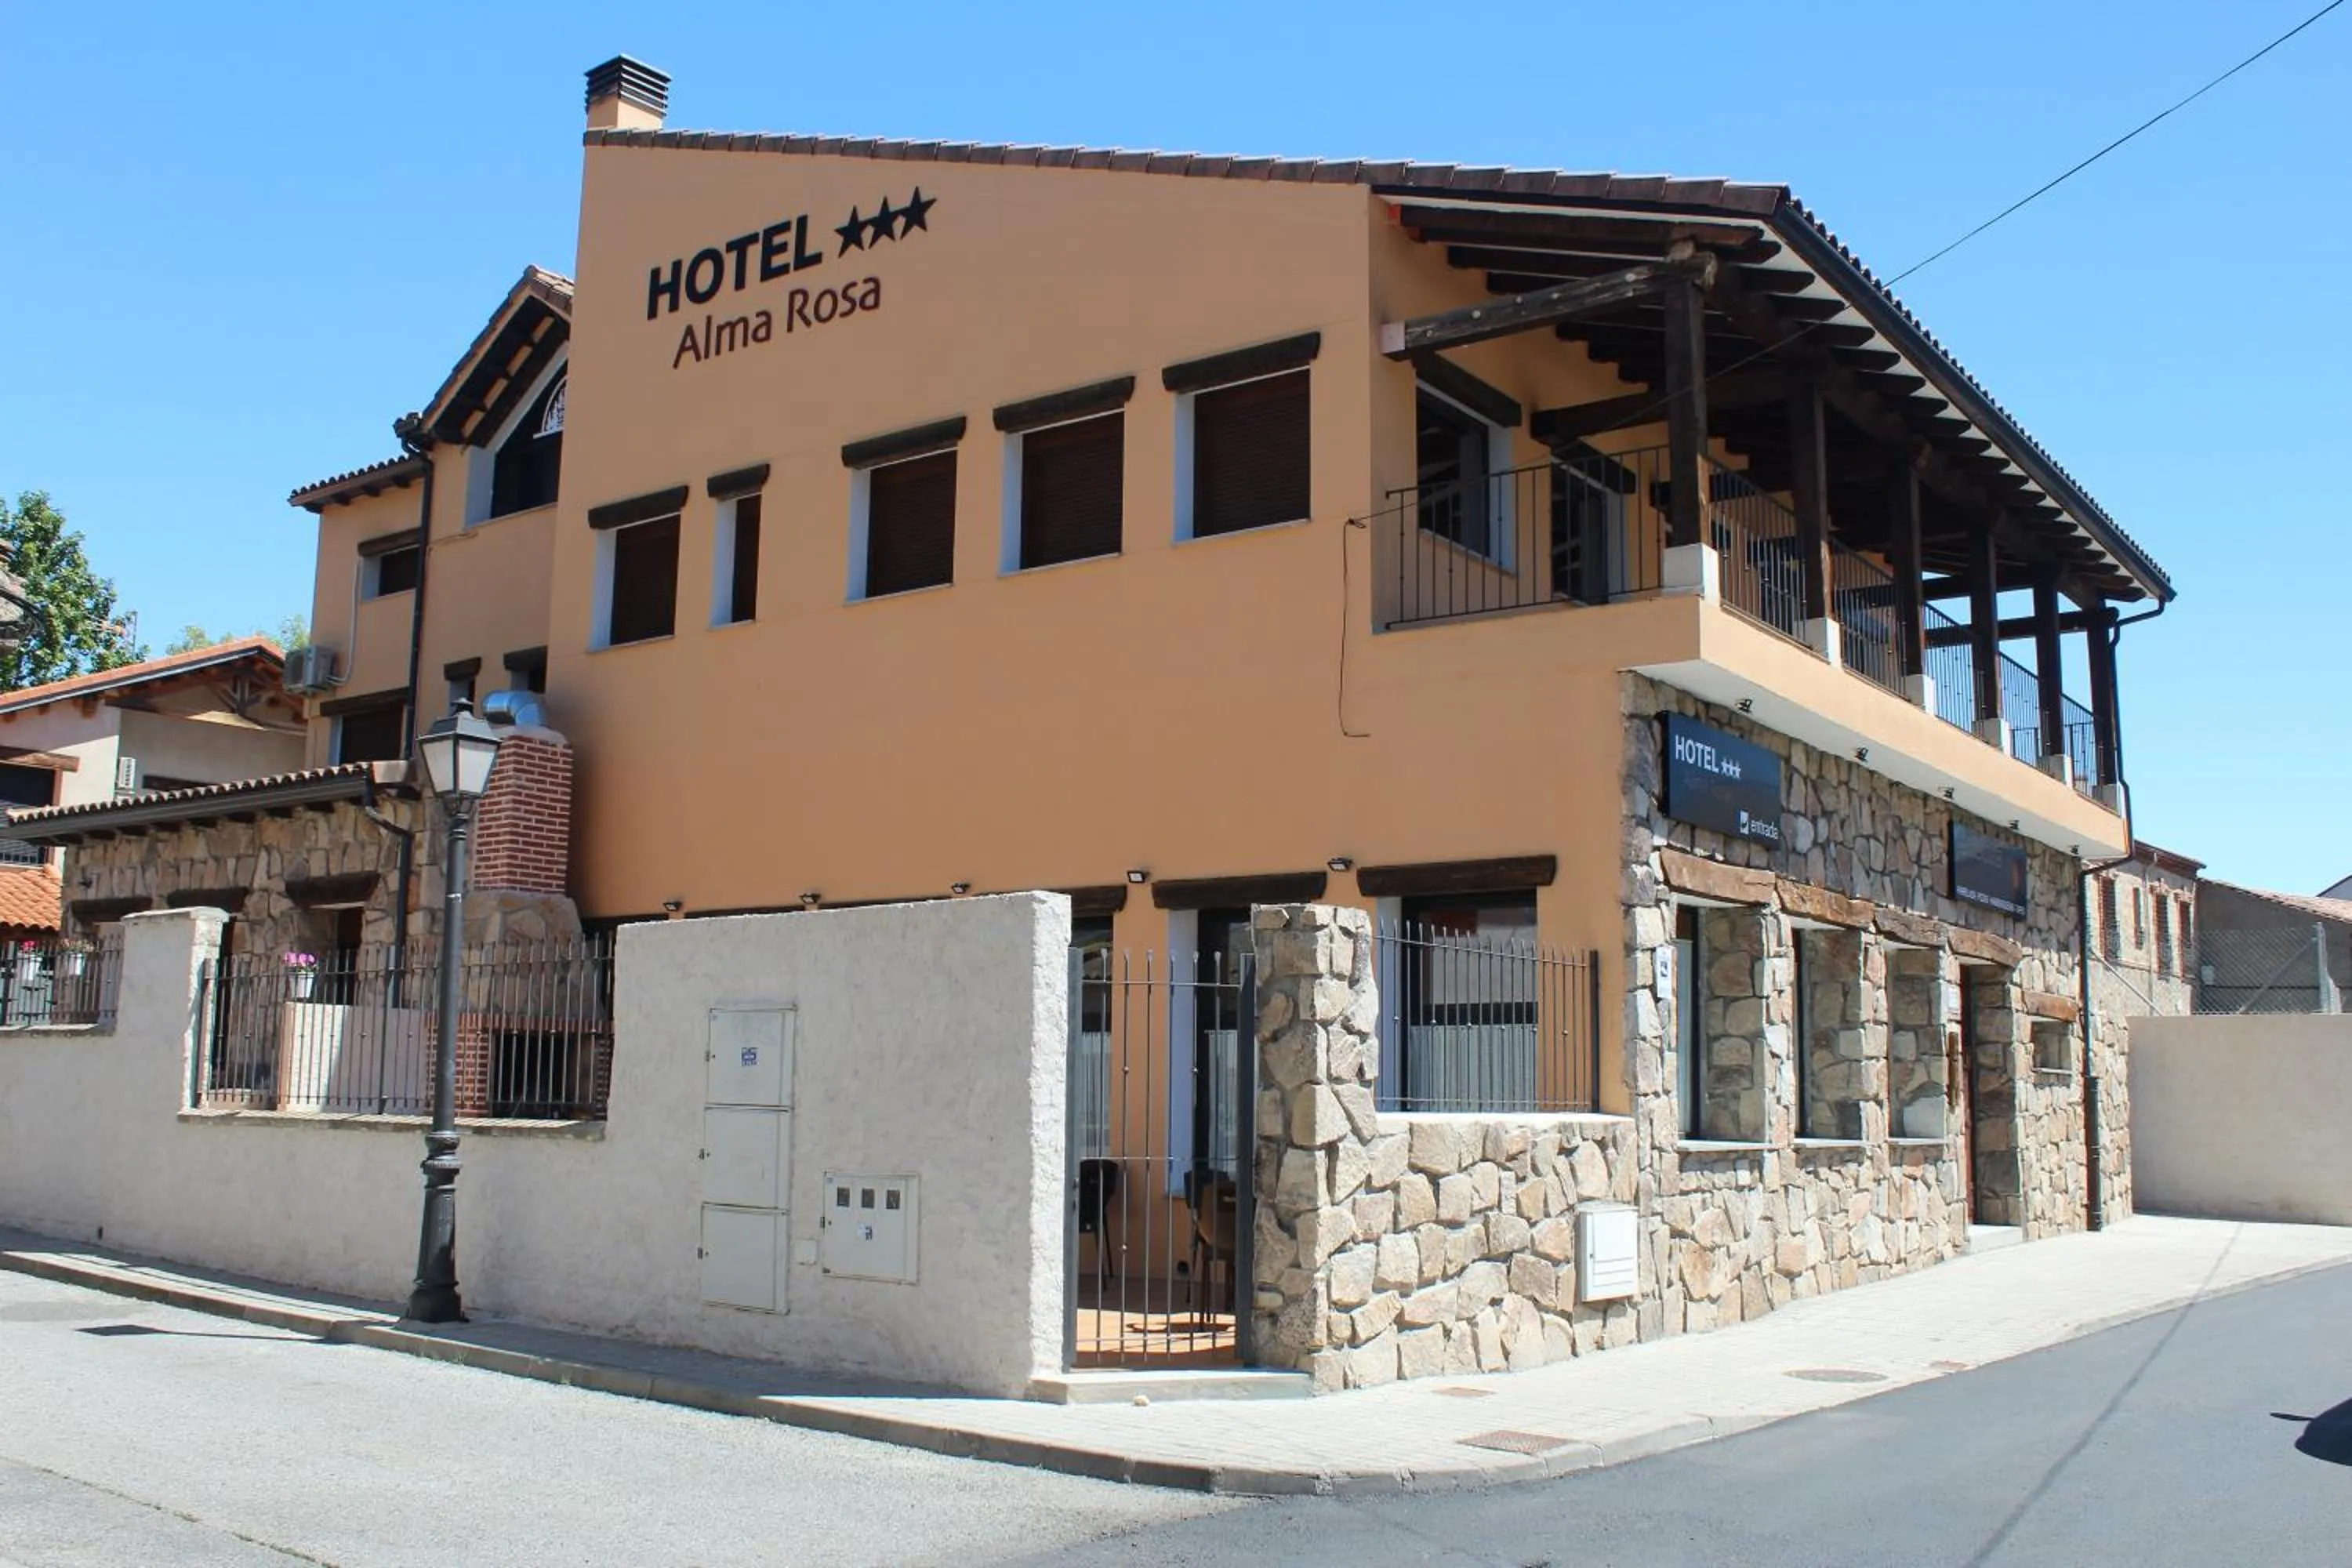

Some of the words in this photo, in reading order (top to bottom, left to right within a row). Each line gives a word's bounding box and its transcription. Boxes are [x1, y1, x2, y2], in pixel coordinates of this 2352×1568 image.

[647, 214, 822, 321] HOTEL
[673, 310, 772, 369] Alma
[786, 276, 881, 333] Rosa
[1675, 734, 1719, 774] HOTEL
[1751, 819, 1778, 839] entrada
